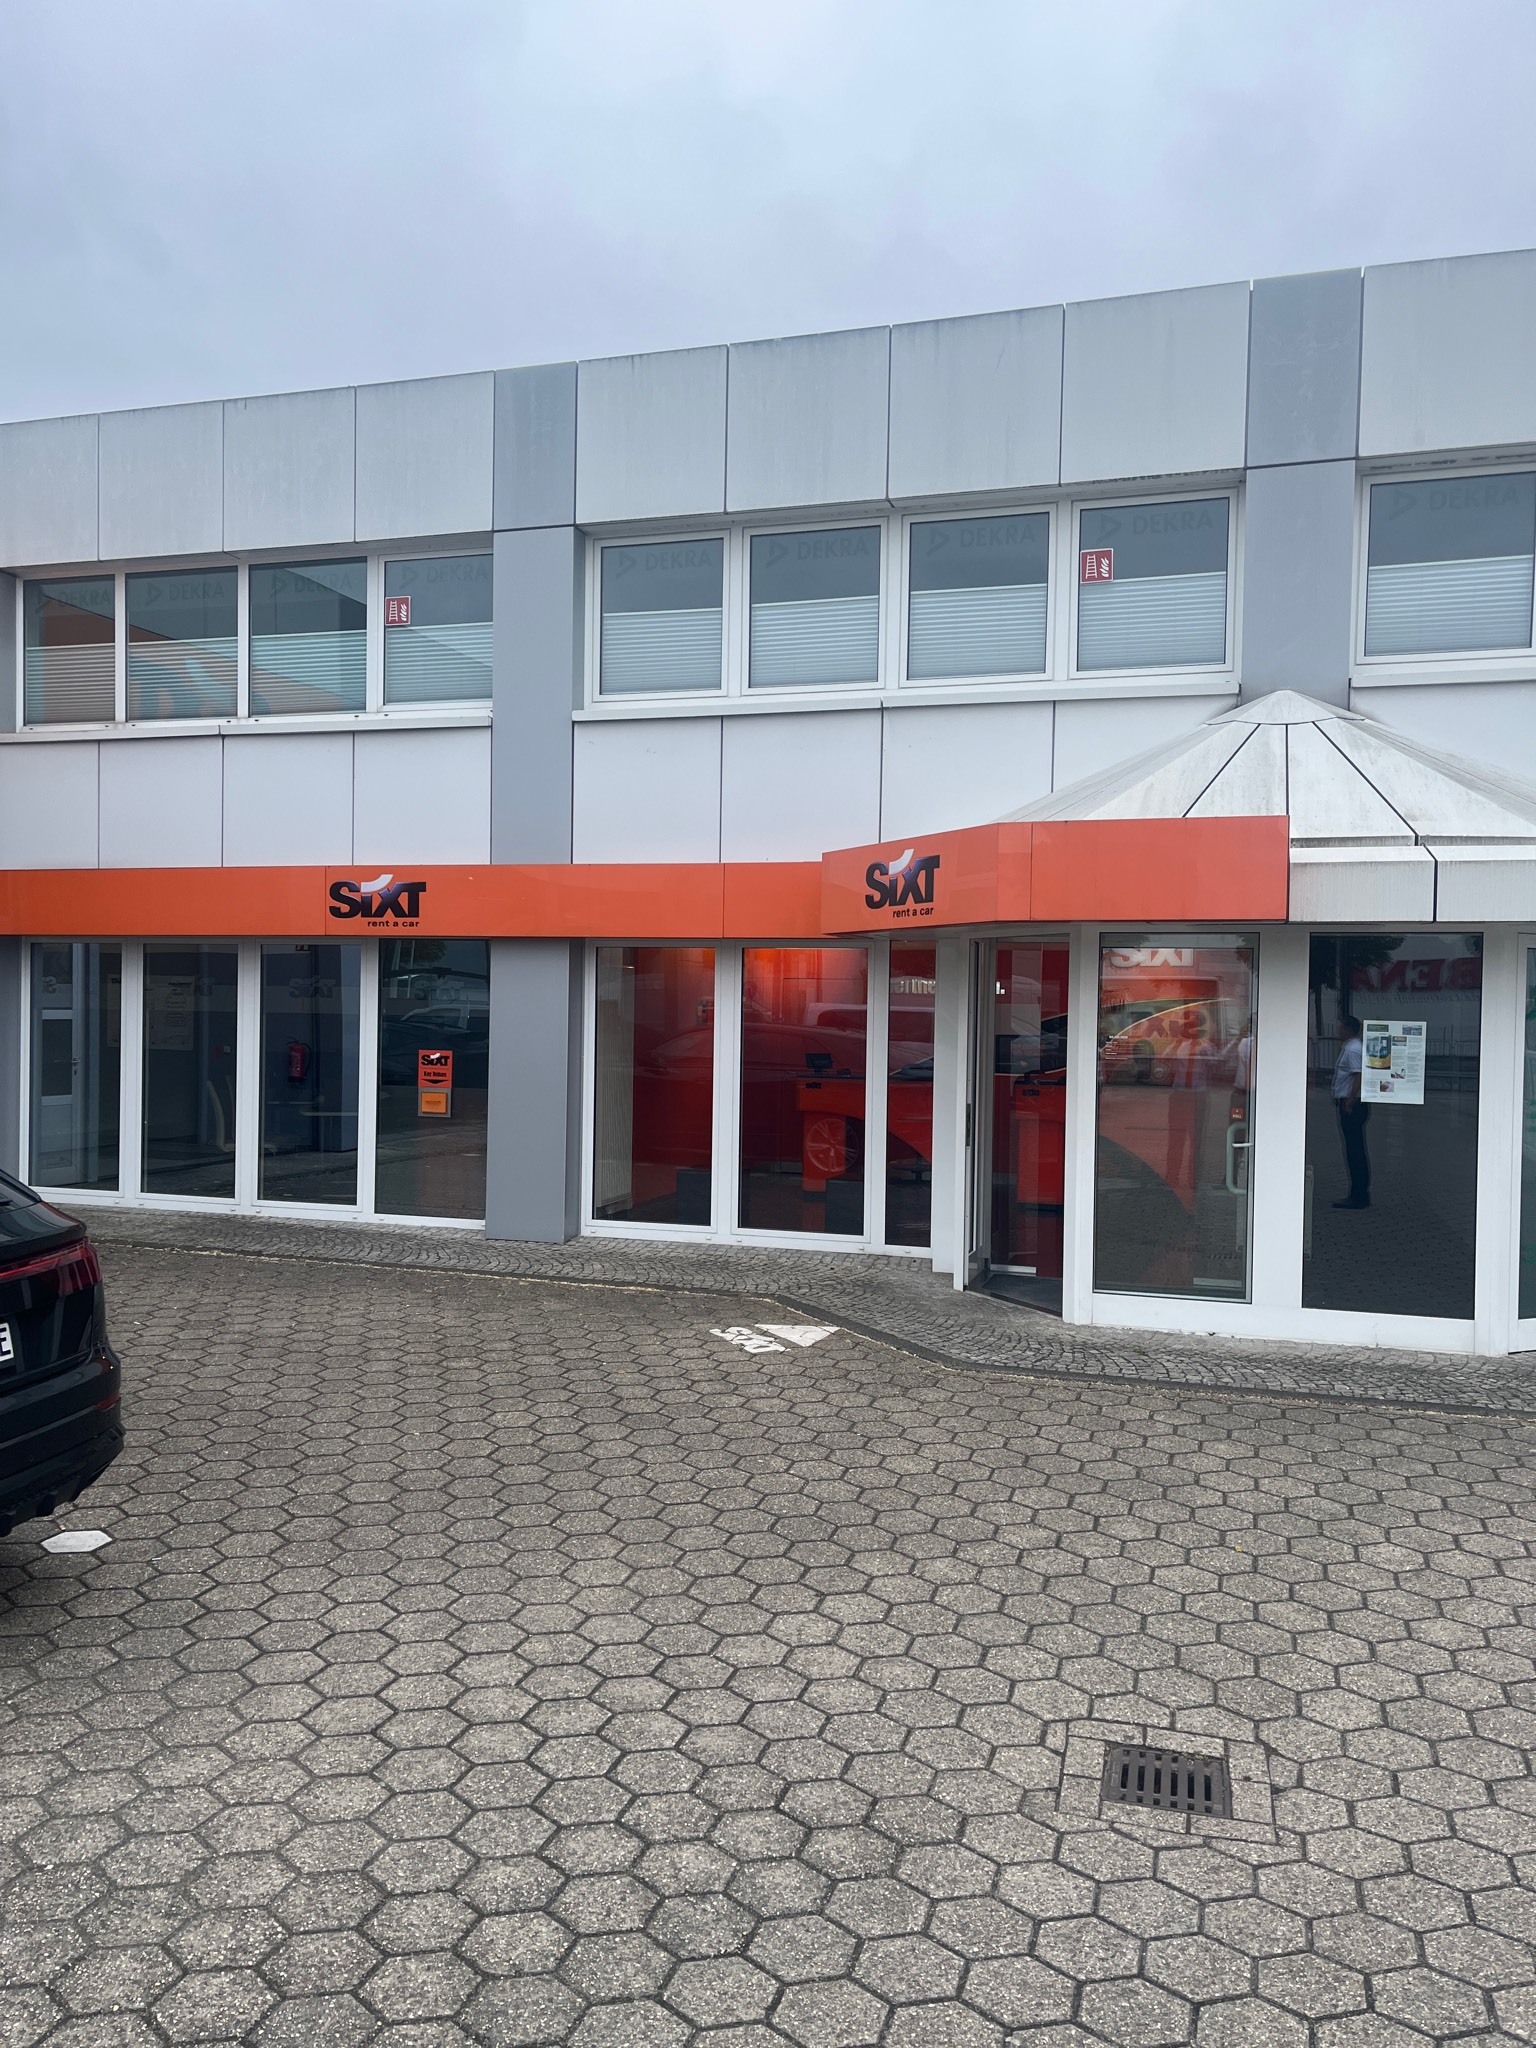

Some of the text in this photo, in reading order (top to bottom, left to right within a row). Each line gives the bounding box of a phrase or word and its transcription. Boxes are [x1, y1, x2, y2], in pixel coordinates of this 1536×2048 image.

[1429, 484, 1521, 511] DEKRA
[1132, 508, 1214, 535] DEKRA
[959, 523, 1036, 548] DEKRA
[797, 536, 869, 561] DEKRA
[645, 549, 713, 571] DEKRA
[294, 572, 353, 593] DEKRA
[426, 562, 490, 584] DEKRA
[58, 588, 112, 608] DEKRA
[169, 582, 225, 601] DEKRA
[892, 906, 934, 918] rent a car
